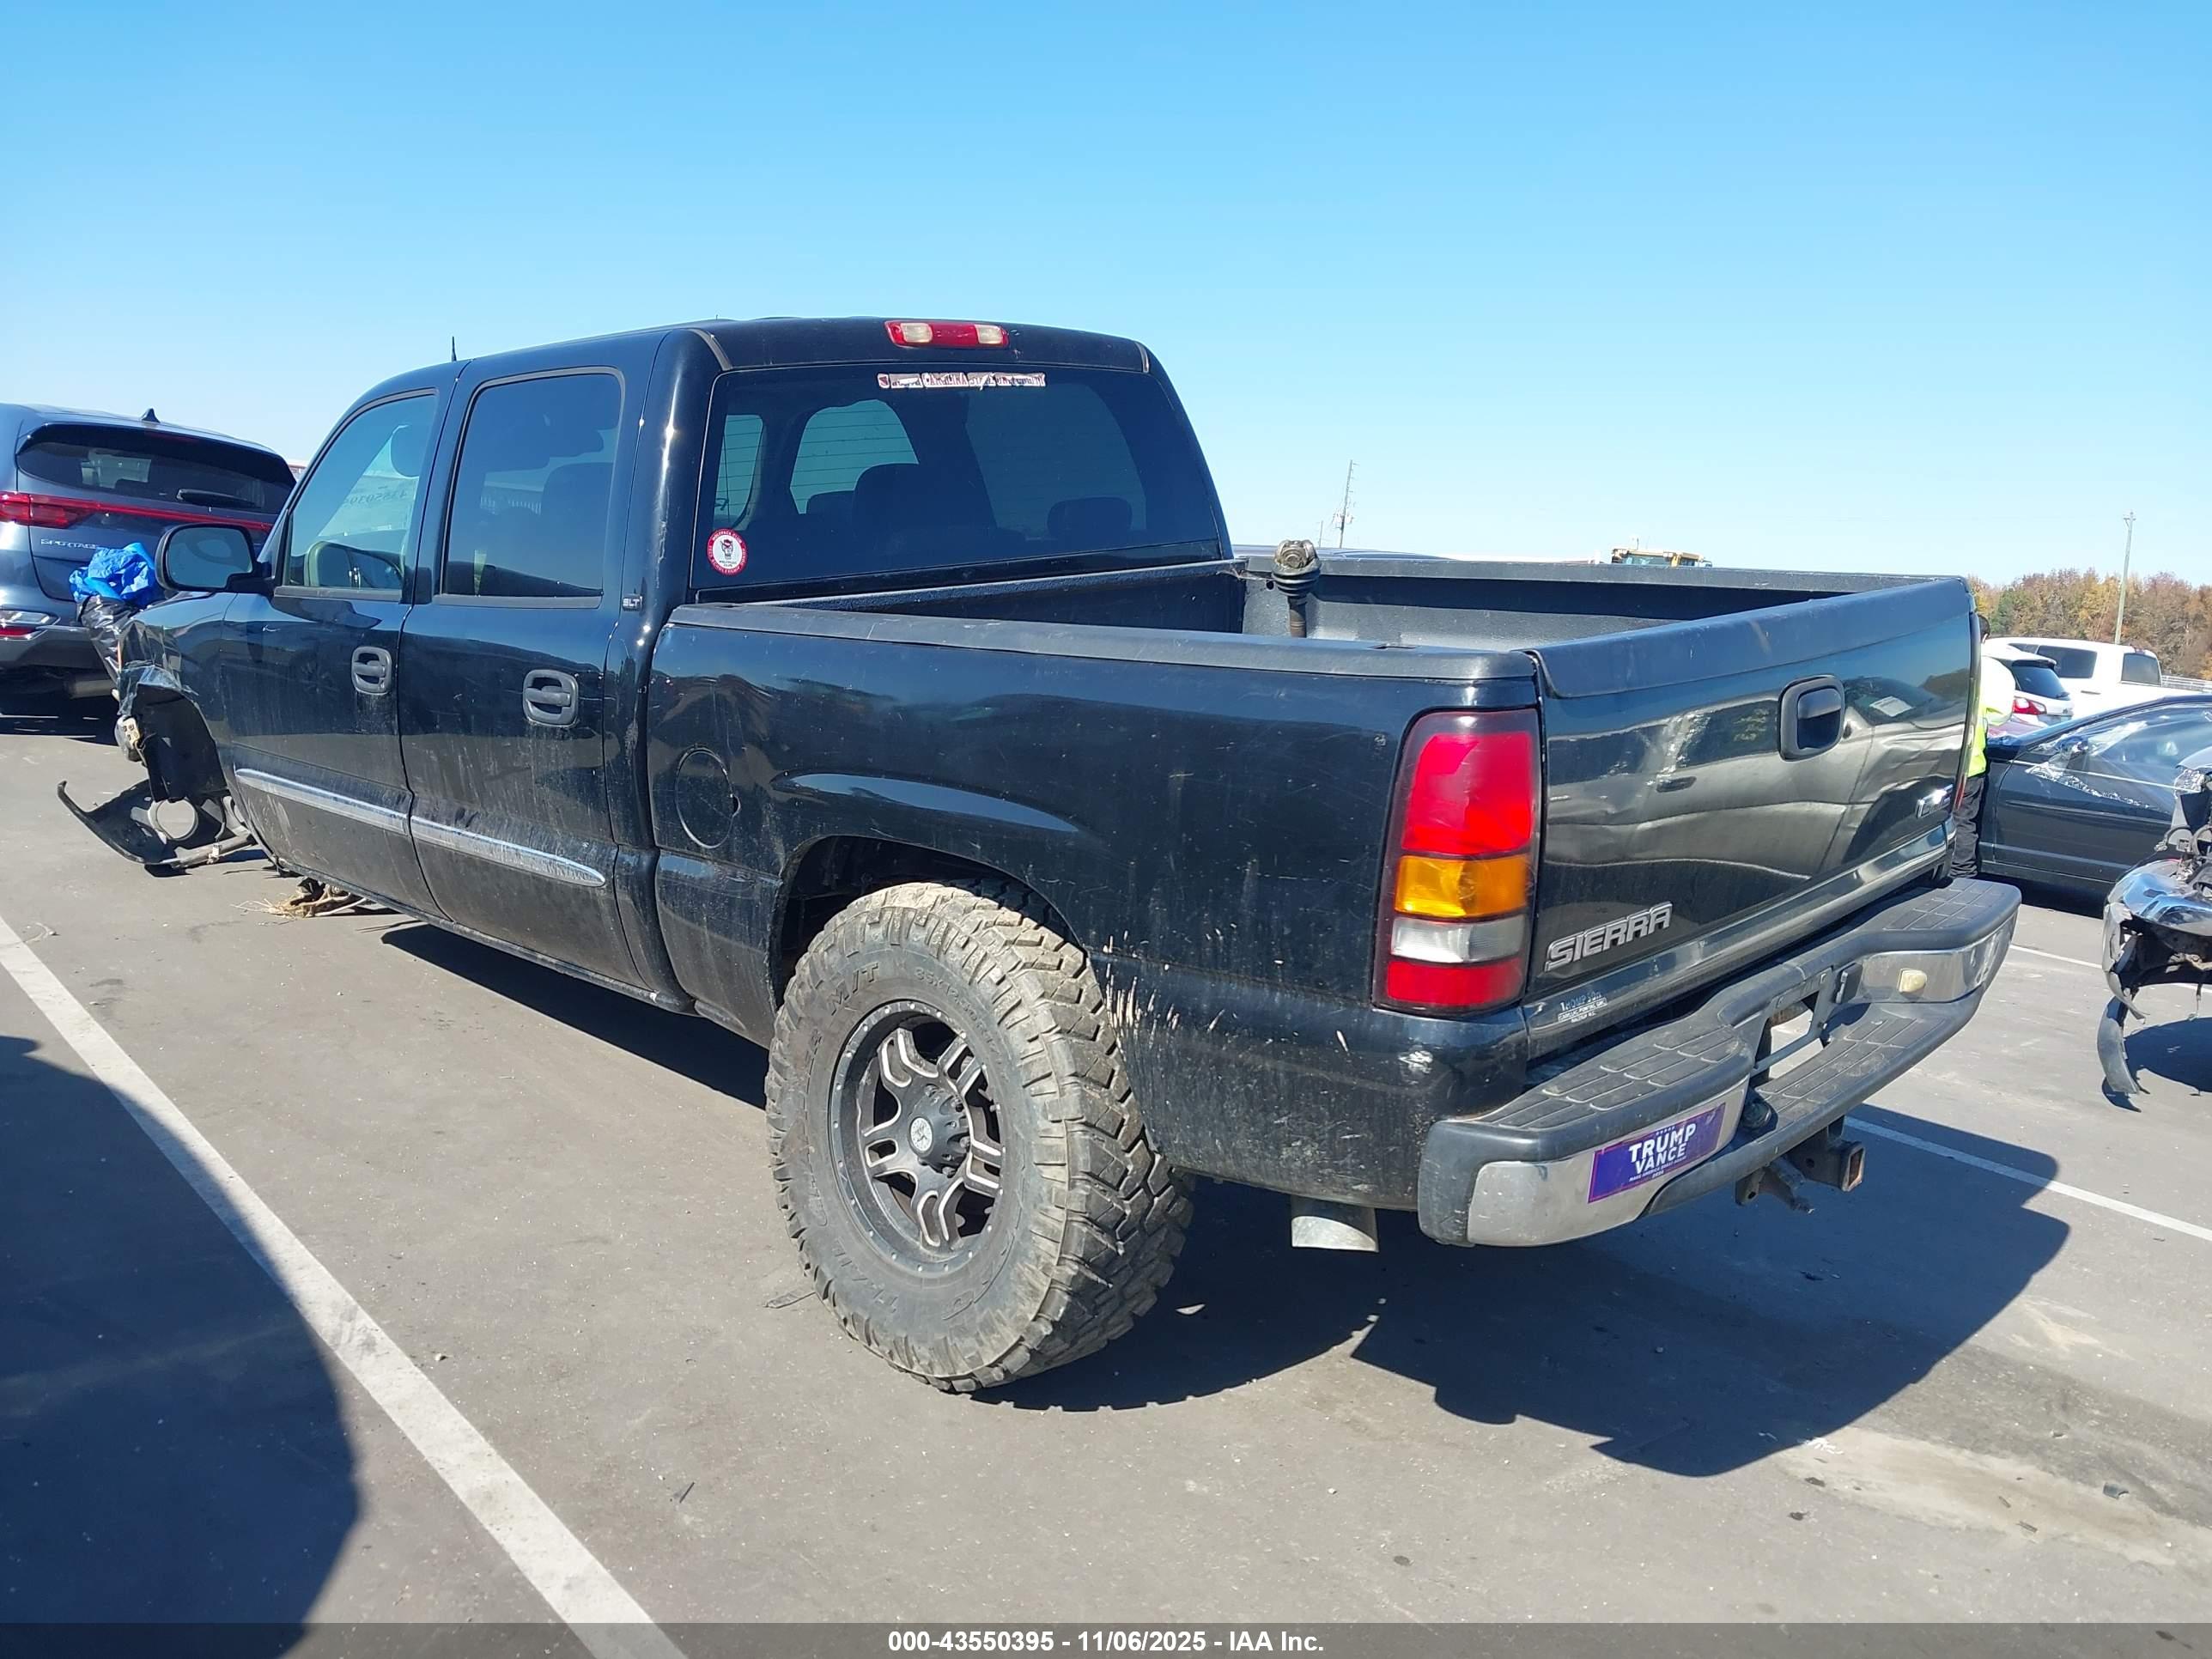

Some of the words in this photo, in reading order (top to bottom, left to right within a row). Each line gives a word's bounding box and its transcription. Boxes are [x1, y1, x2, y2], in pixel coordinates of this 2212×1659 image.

[1544, 902, 1673, 972] SIERRA
[1628, 1123, 1697, 1163] TRUMP
[1635, 1143, 1687, 1174] VANCE
